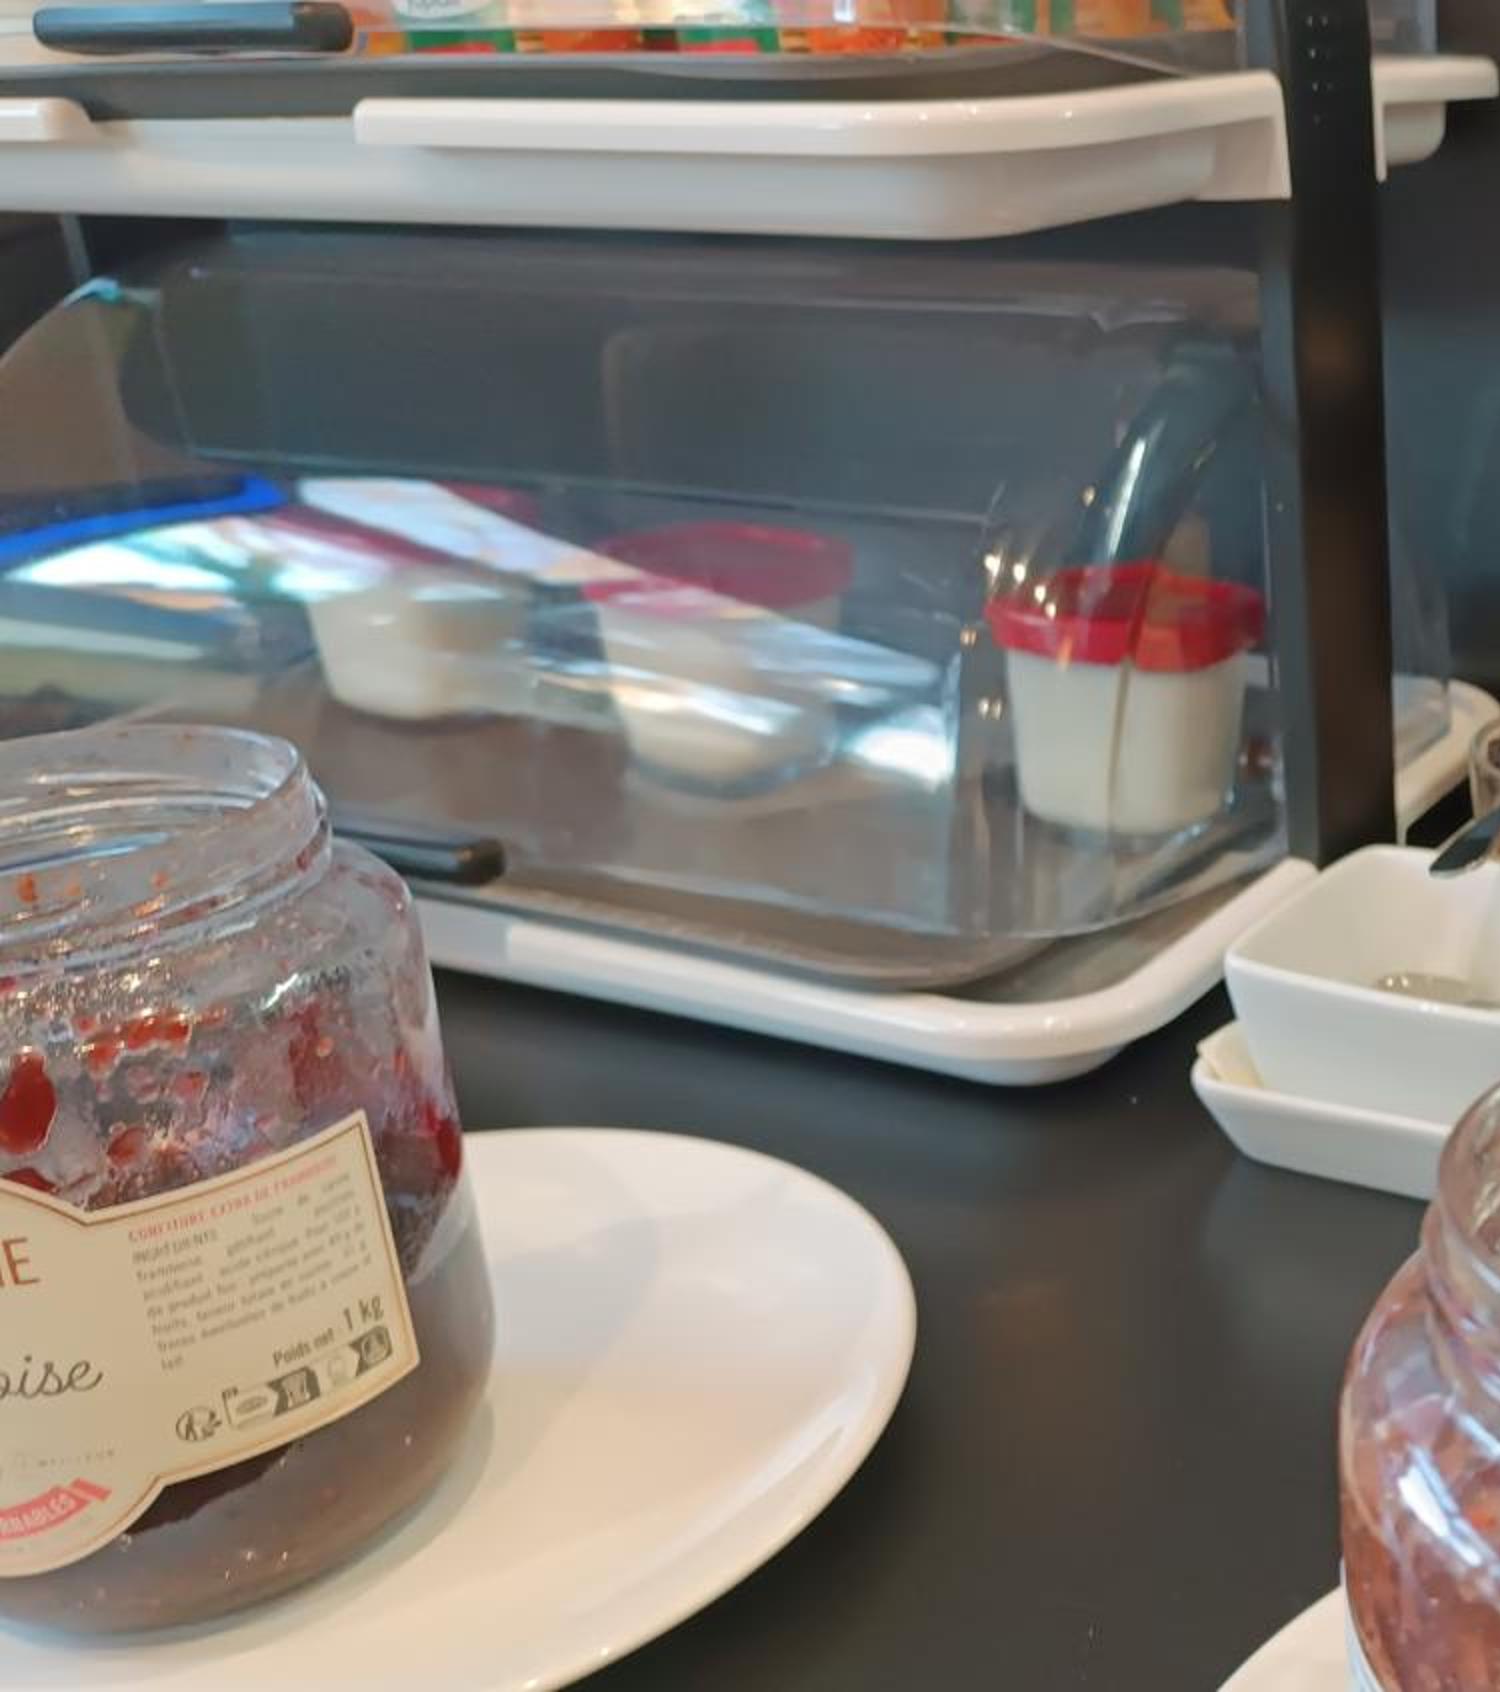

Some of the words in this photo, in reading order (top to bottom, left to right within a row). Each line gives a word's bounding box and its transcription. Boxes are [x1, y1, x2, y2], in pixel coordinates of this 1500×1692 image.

[272, 1336, 312, 1368] Poids
[343, 1307, 353, 1332] 1
[358, 1294, 385, 1325] kg
